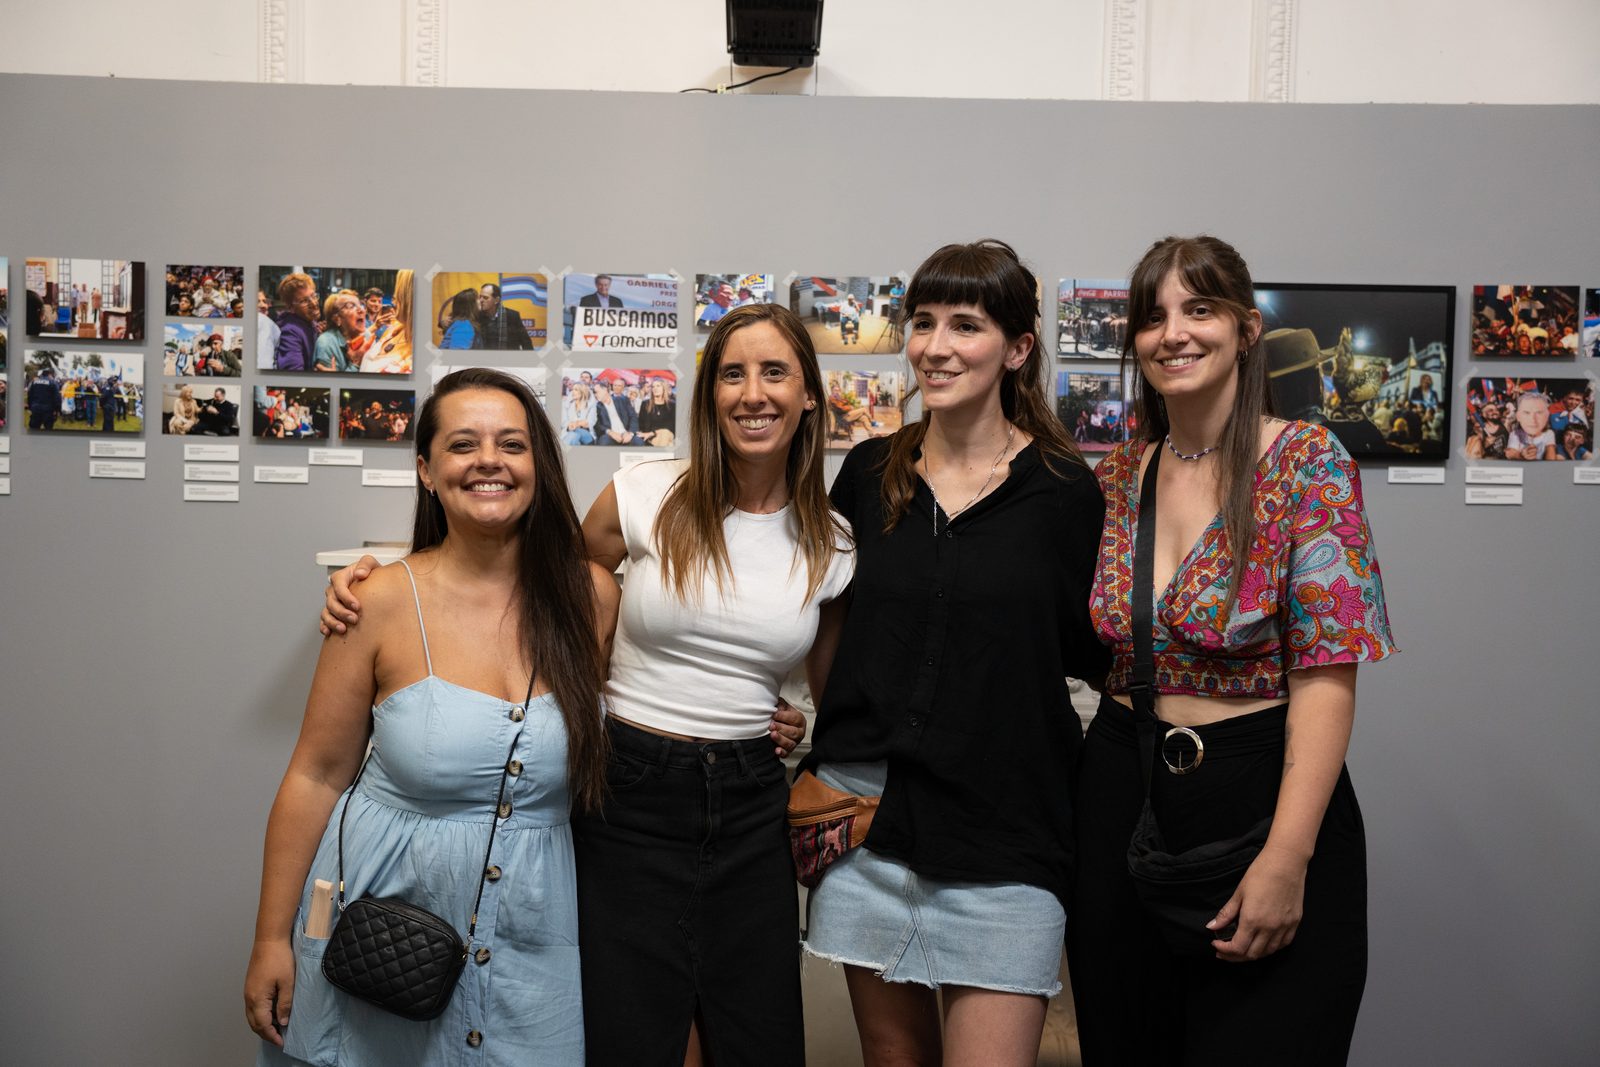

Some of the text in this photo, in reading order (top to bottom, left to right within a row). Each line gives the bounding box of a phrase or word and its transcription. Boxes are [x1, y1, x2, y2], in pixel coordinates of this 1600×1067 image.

[627, 279, 670, 289] GABRIEL
[583, 308, 678, 330] BUSCAMOS
[601, 335, 676, 348] romance
